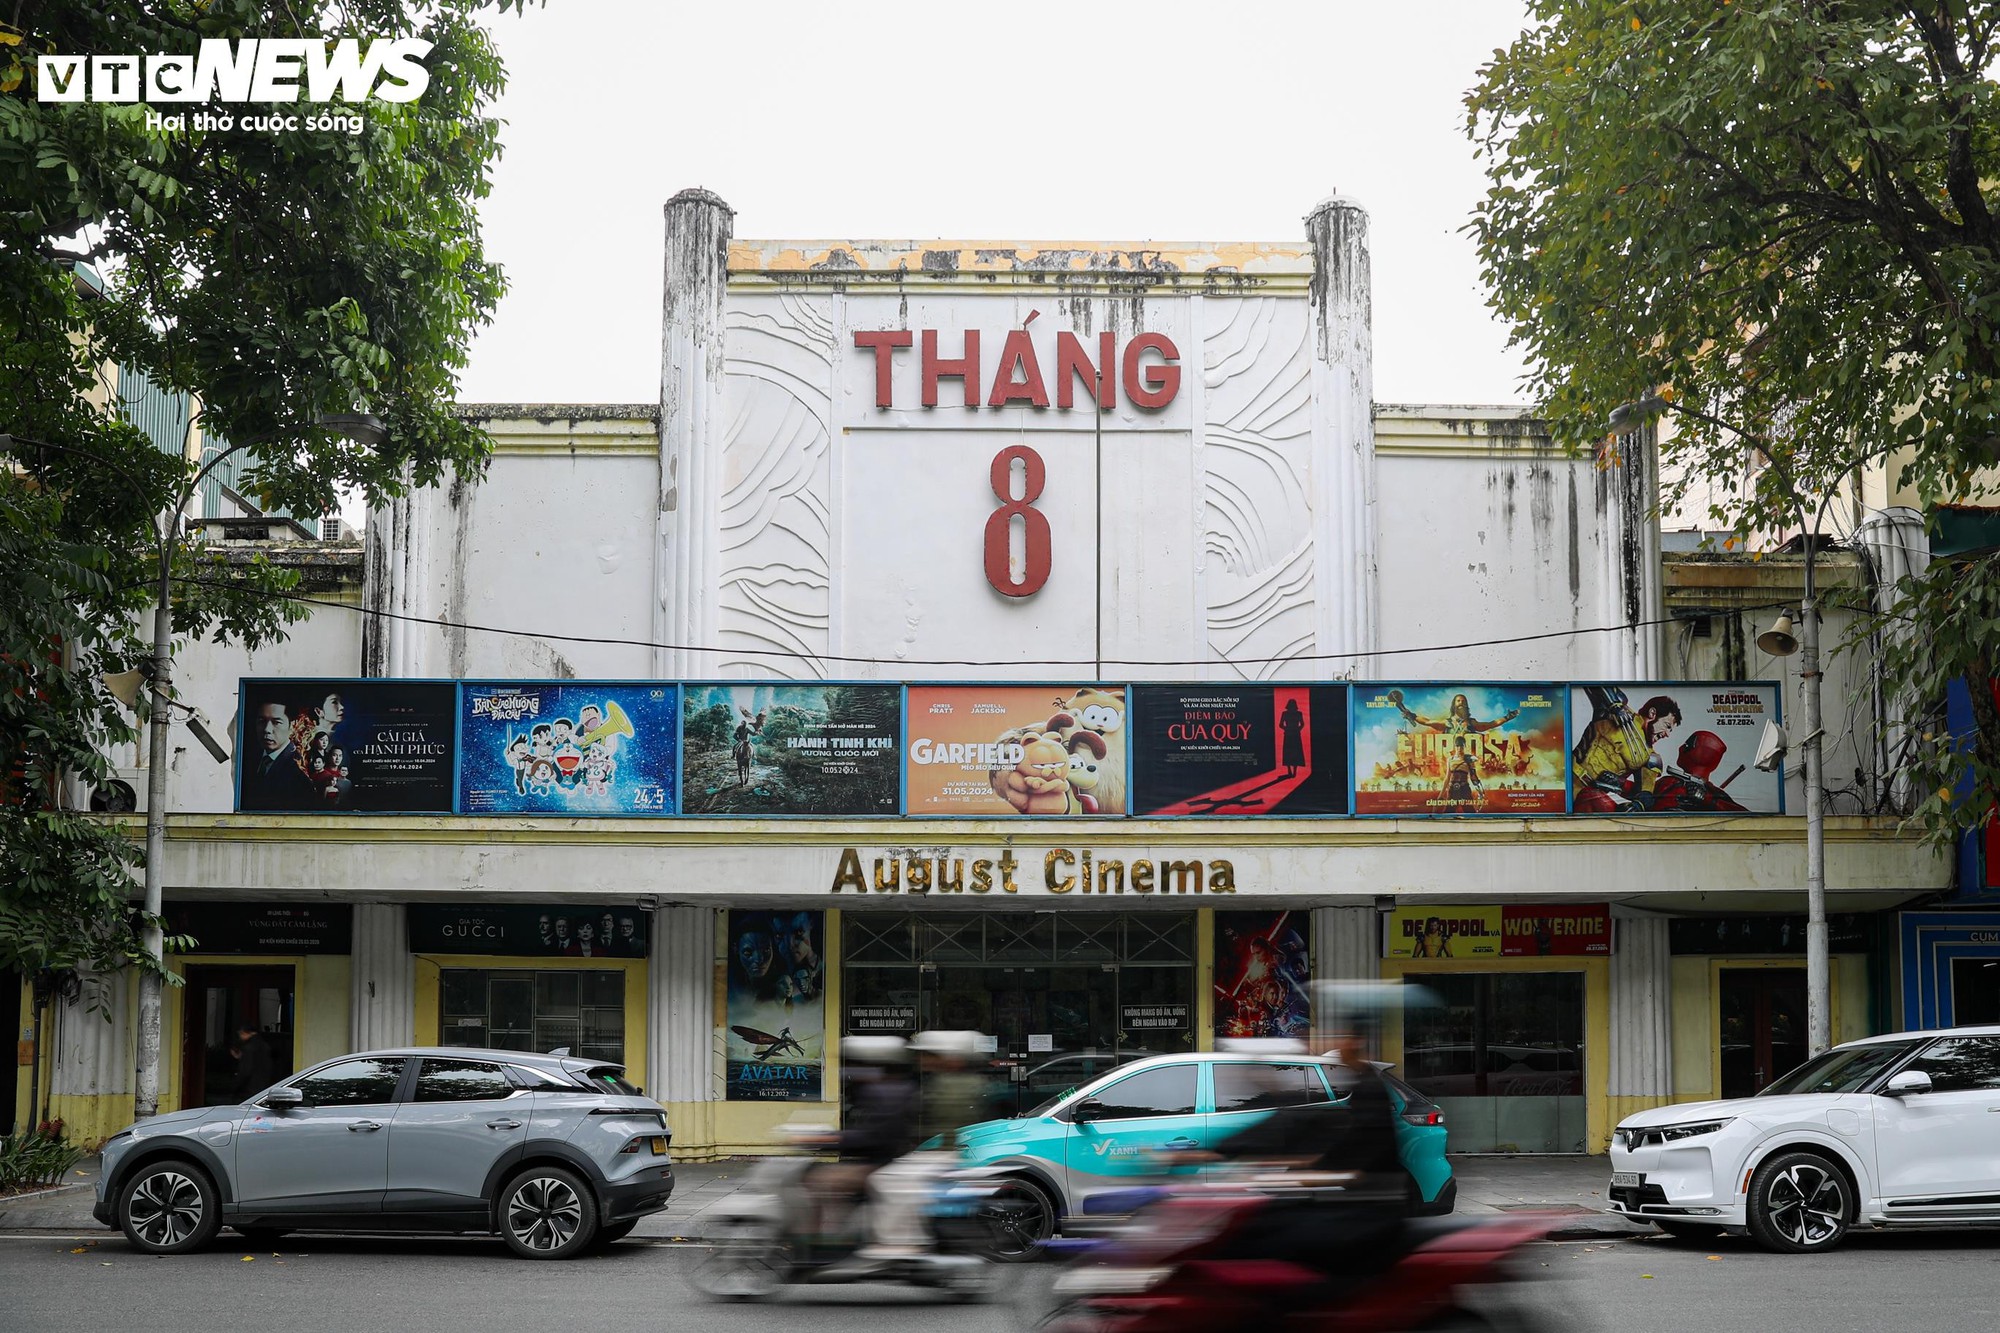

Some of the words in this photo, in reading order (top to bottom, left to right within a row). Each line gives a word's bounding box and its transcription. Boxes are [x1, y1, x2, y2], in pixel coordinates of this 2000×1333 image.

[854, 309, 1182, 409] THÁNG
[984, 445, 1052, 597] 8
[1712, 694, 1761, 705] DEADPOOL
[1712, 704, 1764, 714] WOLVERINE
[377, 729, 400, 742] CÁI
[402, 729, 425, 742] GIÁ
[1168, 721, 1209, 740] CỦA
[1211, 721, 1252, 743] QUỶ
[787, 734, 827, 748] HÀNH
[830, 737, 864, 749] TINH
[867, 734, 893, 749] KHỈ
[364, 744, 405, 756] HẠNH
[408, 741, 446, 755] PHÚC
[910, 738, 1025, 765] GARFIELD
[942, 787, 994, 795] 31.05.2024
[831, 847, 1019, 894] August
[1044, 848, 1237, 894] Cinema
[249, 920, 271, 928] VÙNG
[272, 920, 288, 928] ĐẤT
[442, 925, 504, 938] GUCCI
[1970, 932, 1999, 944] CỤM
[851, 1008, 868, 1017] KHÔNG
[868, 1009, 883, 1017] MANG
[1124, 1007, 1140, 1016] KHÔNG
[1141, 1008, 1155, 1016] MANG
[870, 1018, 885, 1027] NGOÀI
[895, 1019, 906, 1028] RẠP
[1143, 1017, 1157, 1026] NGOÀI
[740, 1064, 808, 1081] AVATAR
[1109, 1147, 1138, 1156] XANH
